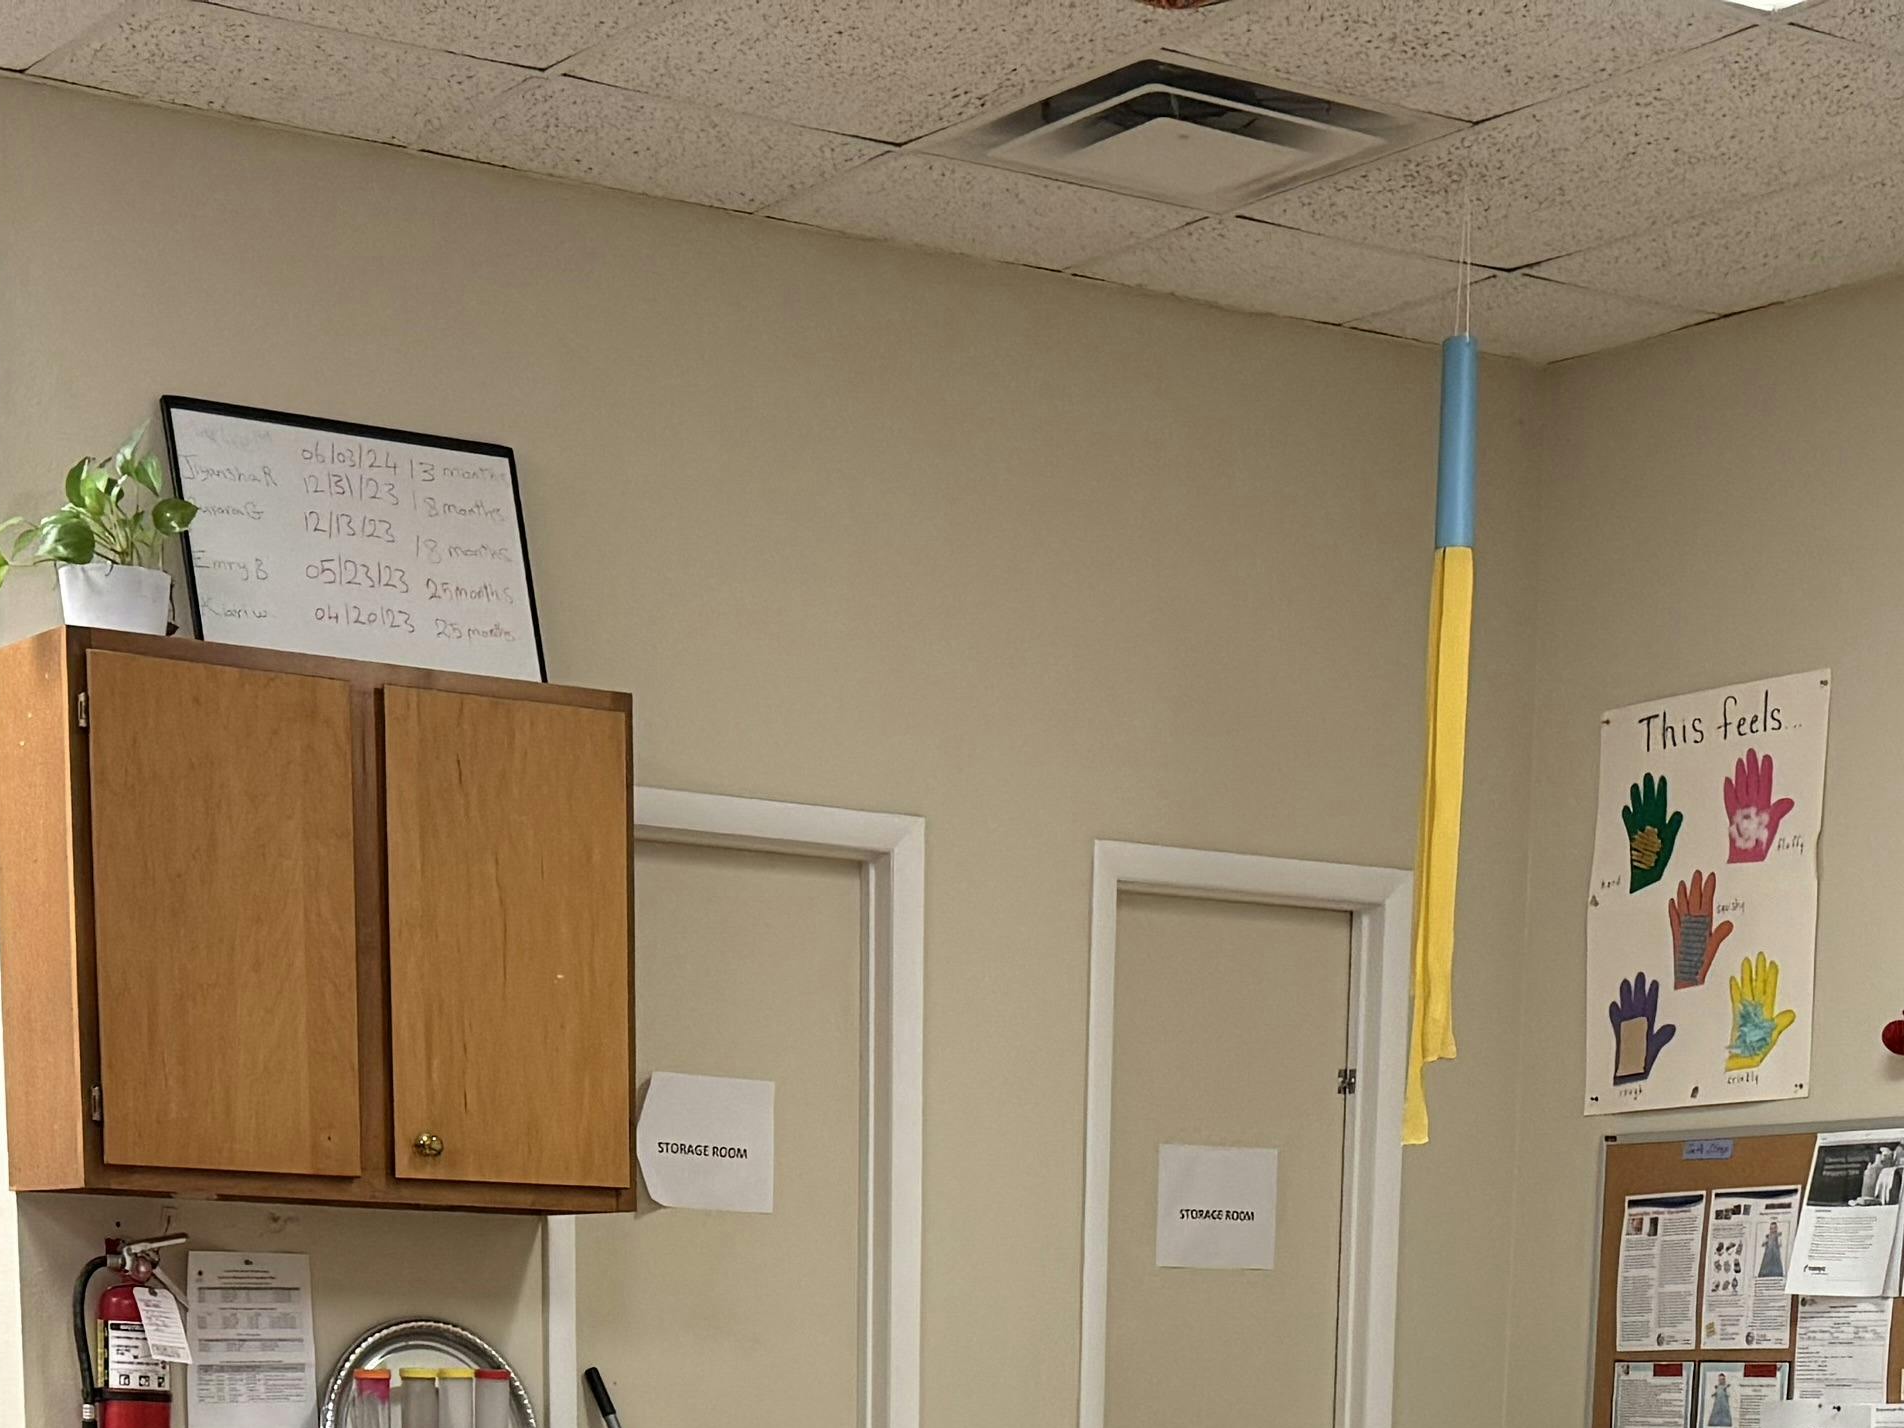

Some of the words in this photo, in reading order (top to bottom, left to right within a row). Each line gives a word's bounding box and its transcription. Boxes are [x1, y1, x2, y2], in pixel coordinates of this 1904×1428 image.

[409, 458, 436, 482] 13
[1638, 710, 1705, 752] This
[657, 1142, 709, 1157] STORAGE
[711, 1146, 748, 1159] ROOM
[1179, 1209, 1223, 1220] STORAGE
[1225, 1210, 1255, 1221] ROOM
